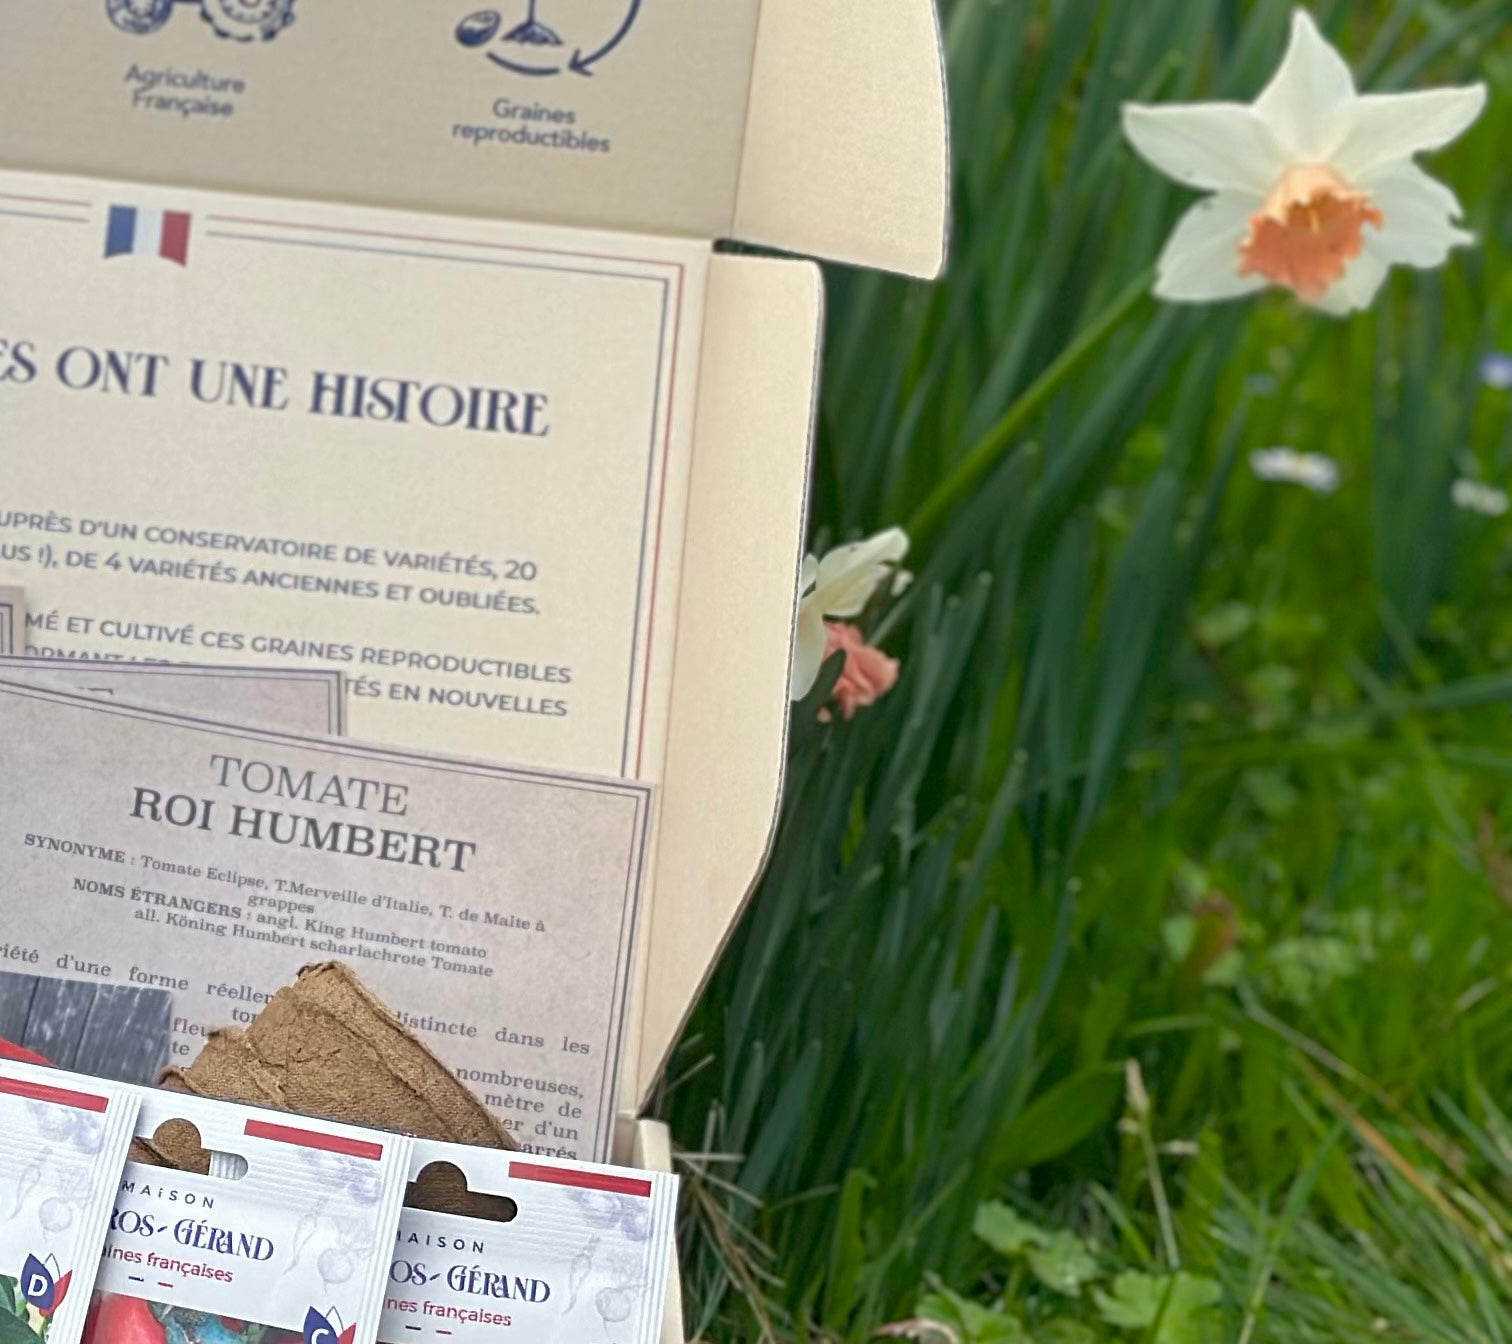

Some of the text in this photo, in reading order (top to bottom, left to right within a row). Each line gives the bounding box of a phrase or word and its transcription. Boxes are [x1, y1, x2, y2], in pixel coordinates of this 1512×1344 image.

[125, 64, 245, 94] Agriculture
[134, 90, 233, 117] Française
[493, 99, 576, 124] Graines
[452, 124, 610, 152] reproductibles
[56, 348, 168, 396] ONT
[191, 359, 287, 410] UNE
[310, 372, 548, 436] HISTOIRE
[79, 519, 137, 540] D'UN
[144, 526, 337, 561] CONSERVATOIRE
[344, 546, 376, 565] DE
[383, 550, 498, 580] VARIÉTÉS,
[504, 559, 538, 581] 20
[65, 550, 97, 569] DE
[104, 552, 122, 571] 4
[128, 556, 237, 583] VARIÉTÉS
[242, 569, 379, 598] ANCIENNES
[385, 583, 413, 602] ET
[419, 587, 540, 615] OUBLIÉES.
[25, 611, 572, 684] MÉ ET CULTIVÉ CES GRAINES REPRODUCTIBLES
[346, 675, 568, 717] TÉS EN NOUVELLES
[210, 754, 409, 816] TOMATE
[130, 787, 476, 872] ROI HUMBERT
[24, 833, 126, 863] SYNONYME
[141, 855, 201, 877] Tomate
[207, 867, 268, 890] Eclipse,
[372, 895, 433, 917] d'Italie,
[458, 908, 479, 922] de
[73, 878, 487, 958] NOMS ÉTRANGERS angl. King Humbert tomato
[247, 895, 315, 914] grappes
[134, 908, 494, 977] all. Köning Humbert scharlachrote Tomate
[56, 954, 111, 977] d'une
[129, 966, 189, 990] forme
[495, 1027, 544, 1048] dans
[562, 1036, 590, 1055] les
[455, 1067, 584, 1099] nombreuses,
[484, 1094, 582, 1119] mètre de
[534, 1120, 578, 1141] d'un
[122, 1180, 215, 1209] MAISON
[147, 1252, 234, 1283] françaises
[27, 1275, 48, 1297] D
[423, 1300, 512, 1327] françaises
